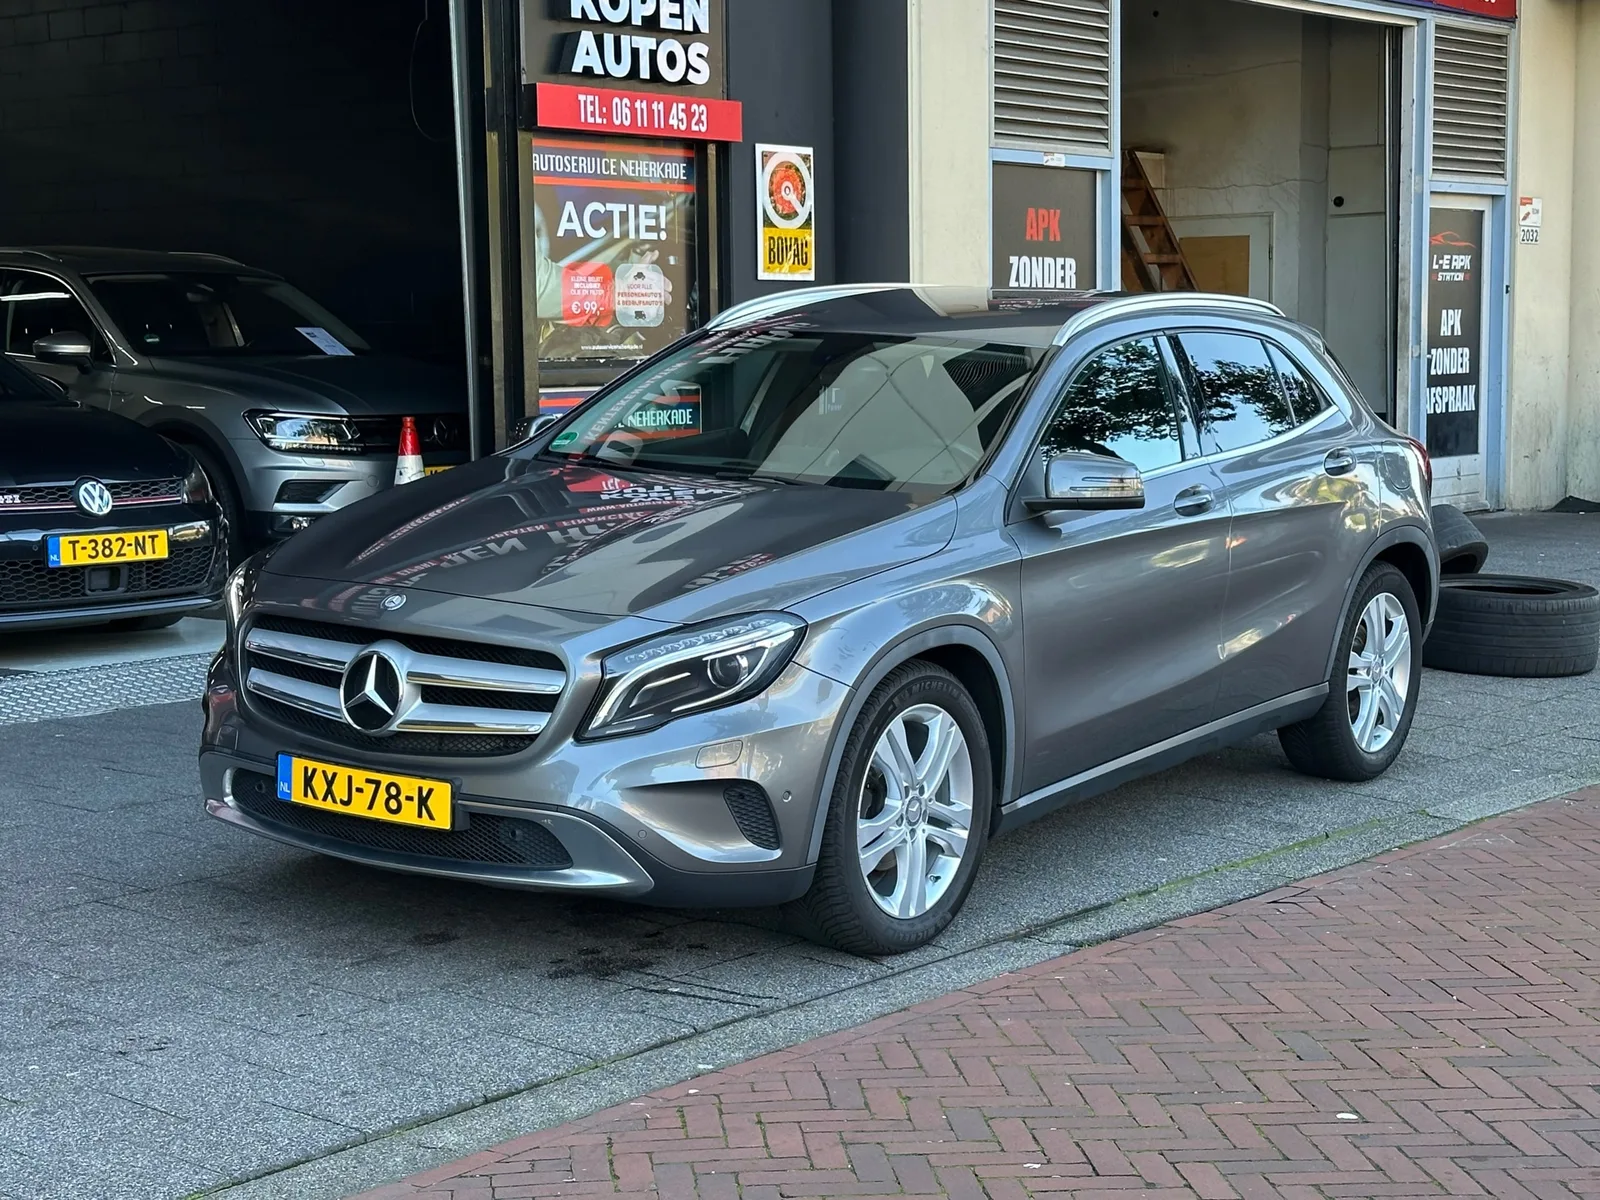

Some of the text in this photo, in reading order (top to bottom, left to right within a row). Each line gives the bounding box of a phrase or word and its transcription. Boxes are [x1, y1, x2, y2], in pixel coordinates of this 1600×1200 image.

[571, 30, 710, 85] AUTOS
[577, 94, 708, 133] TEL: 06 11 11 45 23
[620, 159, 687, 180] NEHERKADE
[556, 201, 667, 241] ACTIE!
[1026, 207, 1061, 242] APK
[1521, 229, 1538, 242] 2032
[768, 236, 808, 266] BOVAG
[1451, 254, 1471, 269] APK
[1009, 255, 1077, 289] ZONDER
[1437, 272, 1464, 281] STATION
[571, 301, 605, 316] € 99,-
[1440, 309, 1462, 337] APK
[1430, 347, 1470, 376] ZONDER
[628, 408, 693, 427] NEHERKADE
[68, 534, 159, 561] T-382-NT
[280, 765, 436, 822] NL KXJ-78-K
